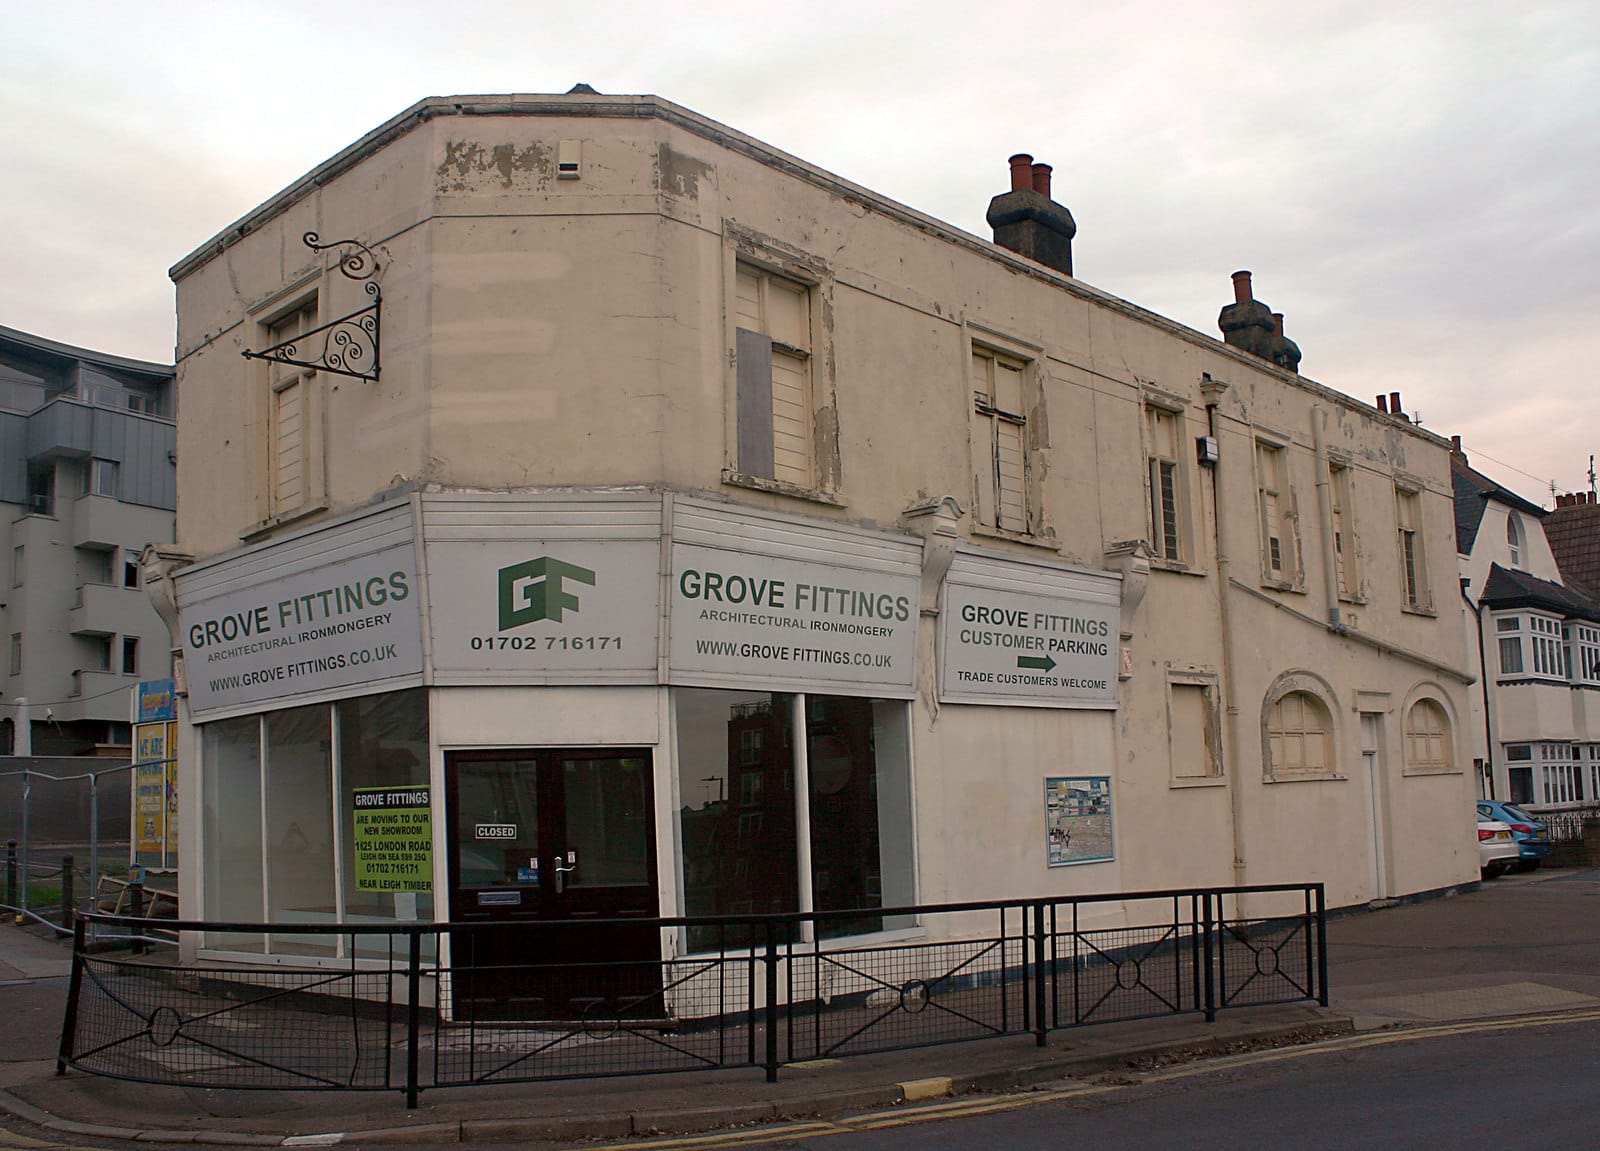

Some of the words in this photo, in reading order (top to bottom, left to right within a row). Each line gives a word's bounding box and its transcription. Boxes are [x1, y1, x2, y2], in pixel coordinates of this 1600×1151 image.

[680, 569, 785, 608] GROVE
[795, 583, 910, 622] FITTINGS
[189, 606, 271, 649] GROVE
[278, 571, 409, 628] FITTINGS
[699, 609, 807, 629] ARCHITECTURAL
[810, 620, 894, 637] IRONMONGERY
[961, 605, 1029, 628] GROVE
[1034, 613, 1108, 636] FITTINGS
[207, 635, 296, 663] ARCHITECTURAL
[298, 613, 392, 643] IRONMONGERY
[470, 636, 537, 650] 01702
[544, 636, 622, 650] 716171
[960, 629, 1044, 650] CUSTOMER
[1049, 638, 1108, 656] PARKING
[696, 640, 789, 661] WWW.GROVE
[793, 648, 892, 668] FITTINGS.CO.UK
[209, 666, 284, 693] WWW.GROVE
[287, 643, 398, 679] FITTINGS.CO.UK
[957, 671, 994, 683] TRADE
[996, 673, 1058, 687] CUSTOMERS
[1061, 678, 1107, 690] WELCOME
[355, 794, 384, 806] GROVE
[387, 792, 429, 805] FITTINGS
[356, 815, 368, 824] ARE
[371, 815, 398, 824] MOVING
[401, 815, 410, 823] TO
[413, 814, 429, 823] OUR
[364, 826, 379, 835] NEW
[381, 826, 422, 835] SHOWROOM
[478, 827, 514, 837] CLOSED
[374, 841, 406, 851] LONDON
[409, 841, 431, 851] ROAD
[360, 853, 376, 861] LEIGH
[388, 853, 400, 861] SEA
[366, 863, 389, 873] 01702
[392, 864, 419, 874] 716171
[359, 879, 377, 889] NEAR
[380, 880, 401, 889] LEIGH
[403, 880, 432, 890] TIMBER
